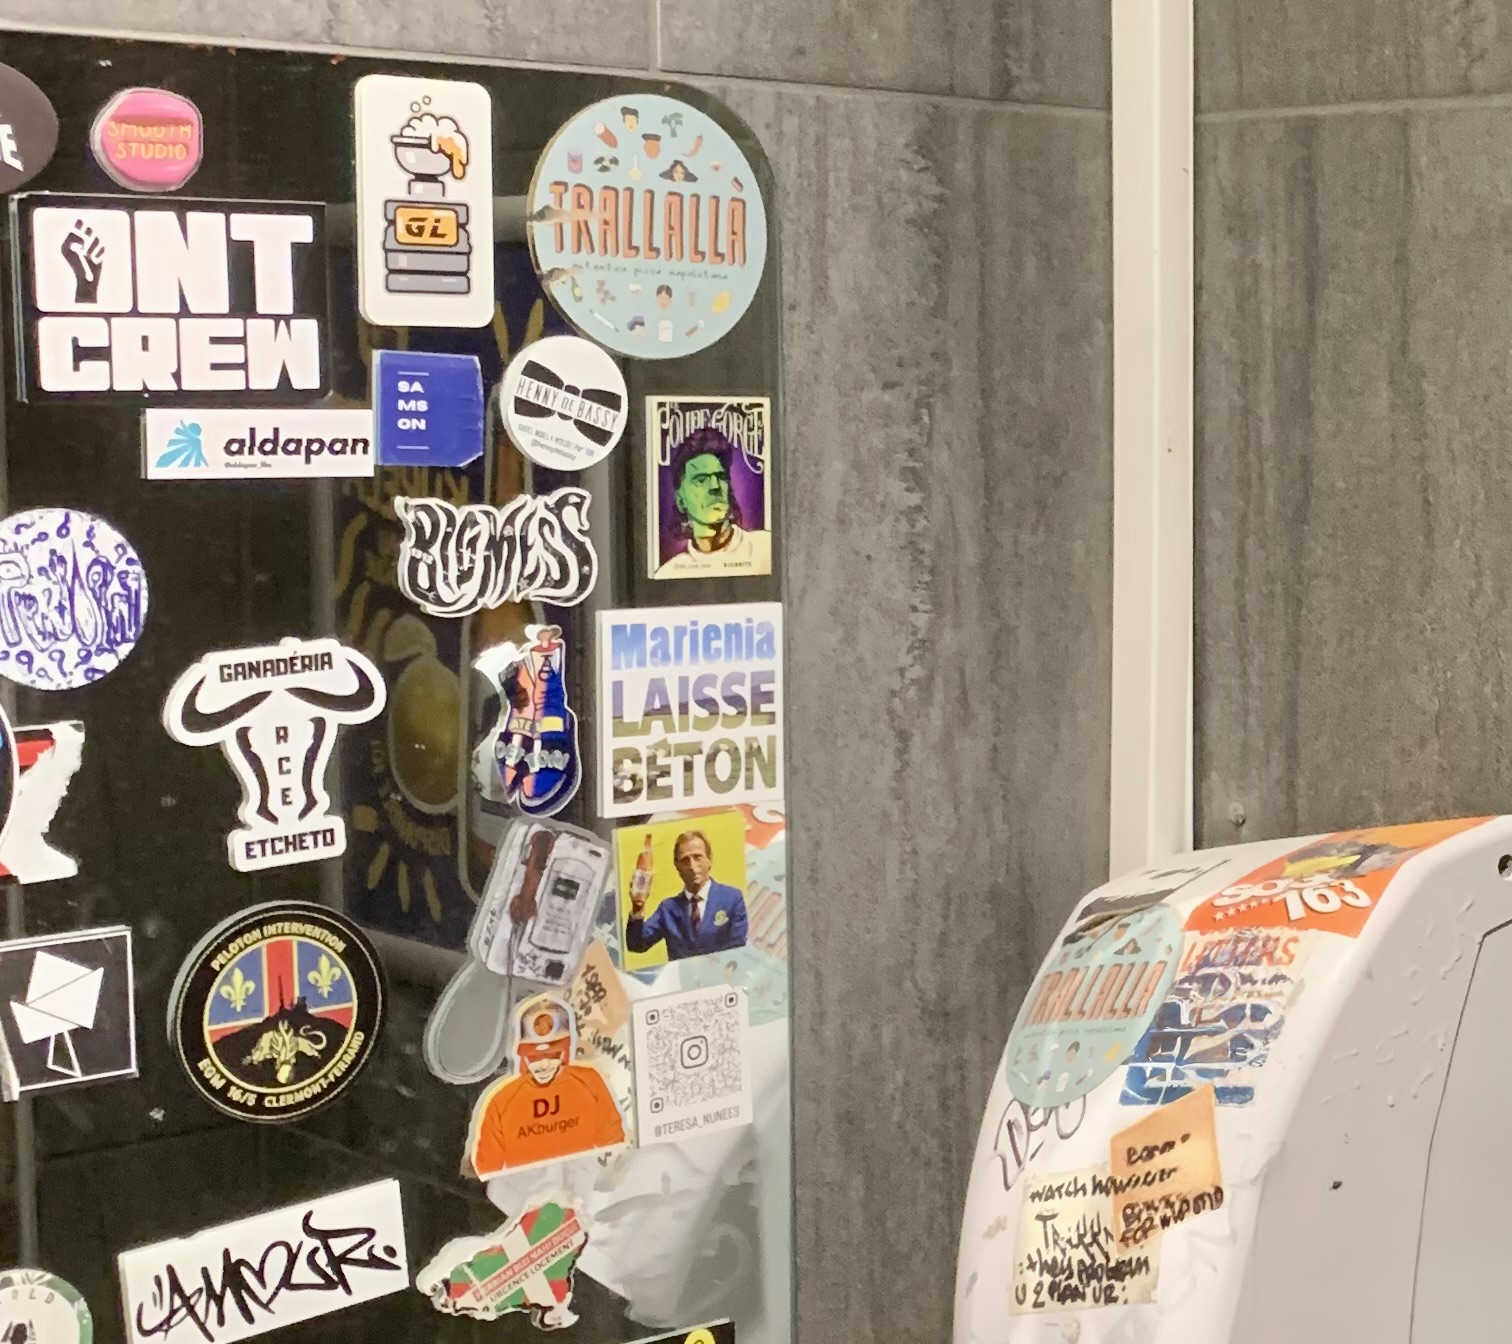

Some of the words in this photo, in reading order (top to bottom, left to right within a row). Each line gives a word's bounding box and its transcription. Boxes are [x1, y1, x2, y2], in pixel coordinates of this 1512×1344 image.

[117, 142, 187, 160] STUDIO
[37, 317, 320, 392] CREW
[516, 376, 560, 408] HENNY
[577, 400, 621, 431] BASSY
[223, 427, 370, 465] aldapan
[611, 617, 775, 670] Marienia
[218, 650, 334, 683] GANADÉRIA
[611, 670, 776, 738] LAISSE
[612, 735, 777, 804] BÉTON
[245, 827, 335, 860] ETCHETO
[1272, 880, 1372, 922] 163
[210, 927, 262, 971] PELOTON
[263, 922, 346, 954] INTERVENTION
[264, 1031, 365, 1107] CLERMONT-FERRAND
[517, 1115, 581, 1140] AKburger
[533, 1096, 560, 1118] DJ
[529, 1239, 576, 1278] LOGEMENT
